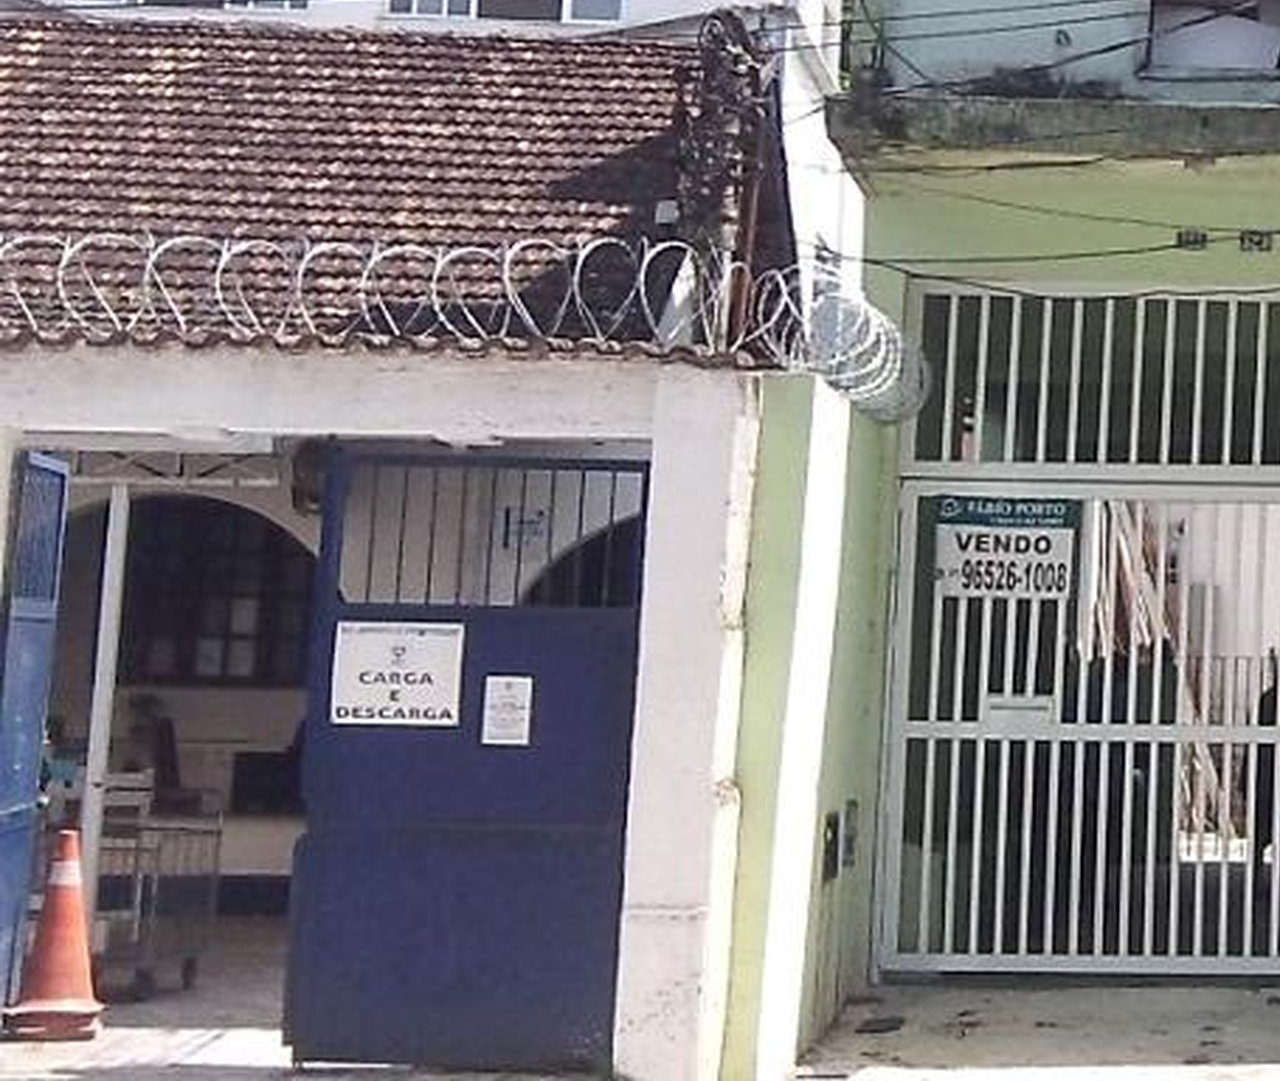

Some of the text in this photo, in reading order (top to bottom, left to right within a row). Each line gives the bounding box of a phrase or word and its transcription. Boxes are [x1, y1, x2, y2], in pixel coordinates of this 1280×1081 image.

[955, 533, 1053, 554] VENDO
[961, 559, 1068, 592] 96526-1008
[358, 672, 434, 686] CARGA
[389, 689, 401, 702] E
[335, 706, 454, 720] DESCARGA
